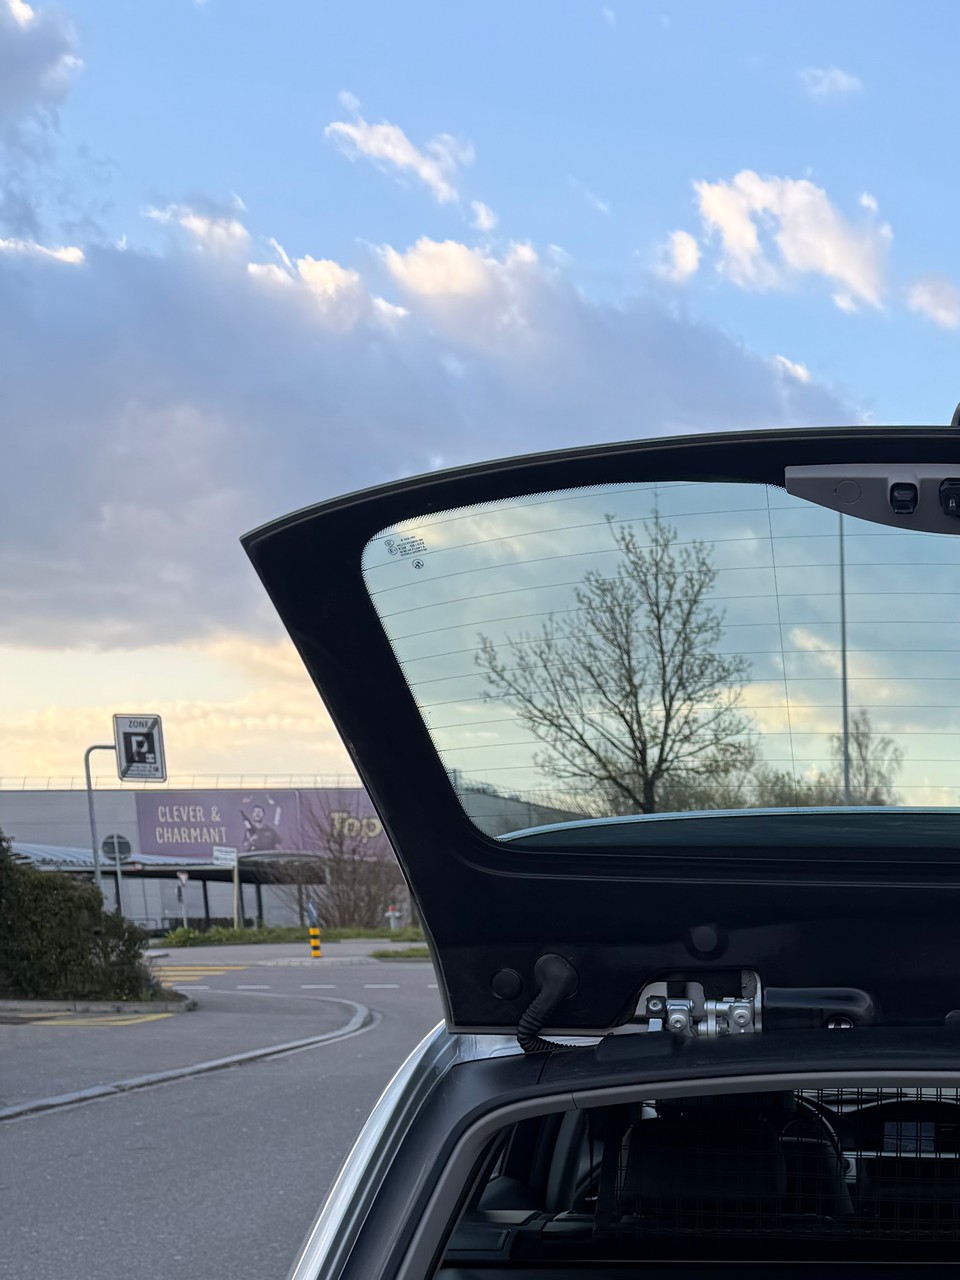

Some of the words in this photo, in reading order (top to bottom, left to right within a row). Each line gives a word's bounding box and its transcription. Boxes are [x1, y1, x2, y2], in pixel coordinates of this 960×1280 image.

[158, 805, 205, 822] CLEVER
[211, 805, 221, 822] &
[155, 827, 226, 844] CHARMANT
